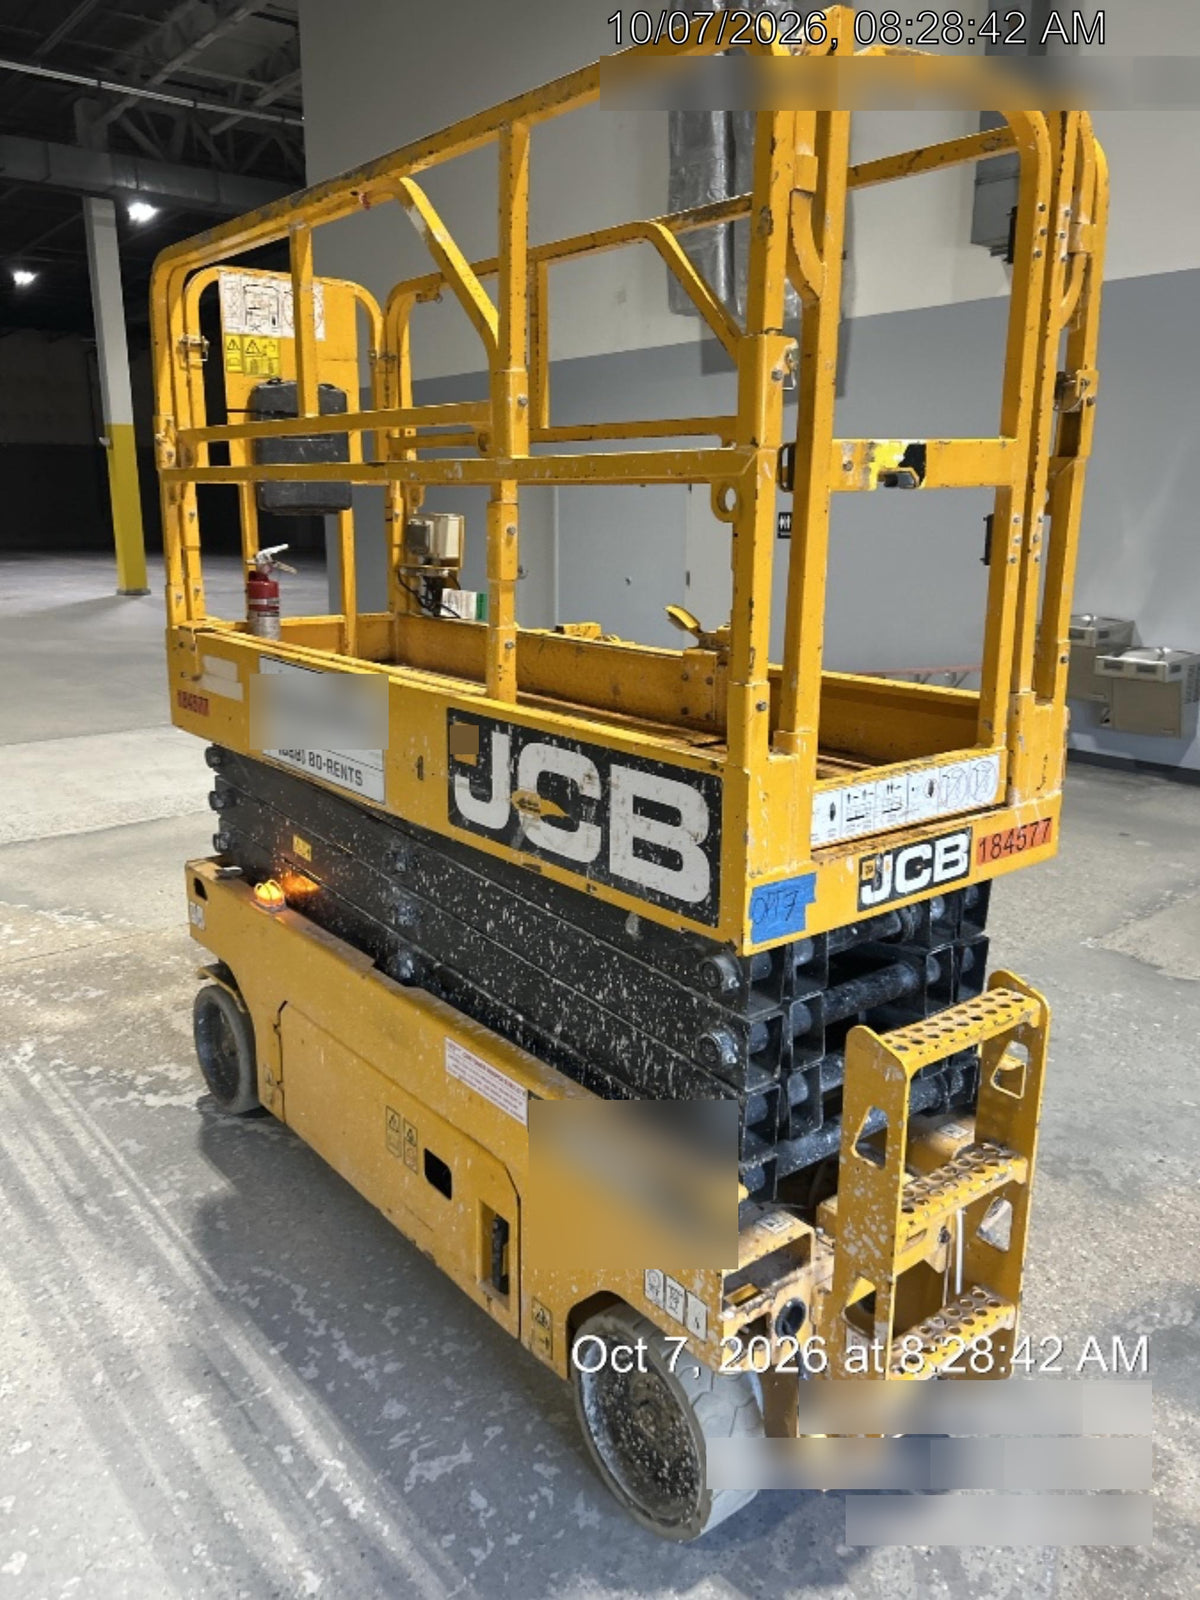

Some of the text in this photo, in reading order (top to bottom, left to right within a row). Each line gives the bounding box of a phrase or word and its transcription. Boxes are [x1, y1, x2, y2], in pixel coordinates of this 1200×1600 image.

[454, 730, 710, 902] JCB
[979, 817, 1052, 863] 184577
[861, 828, 970, 906] JCB
